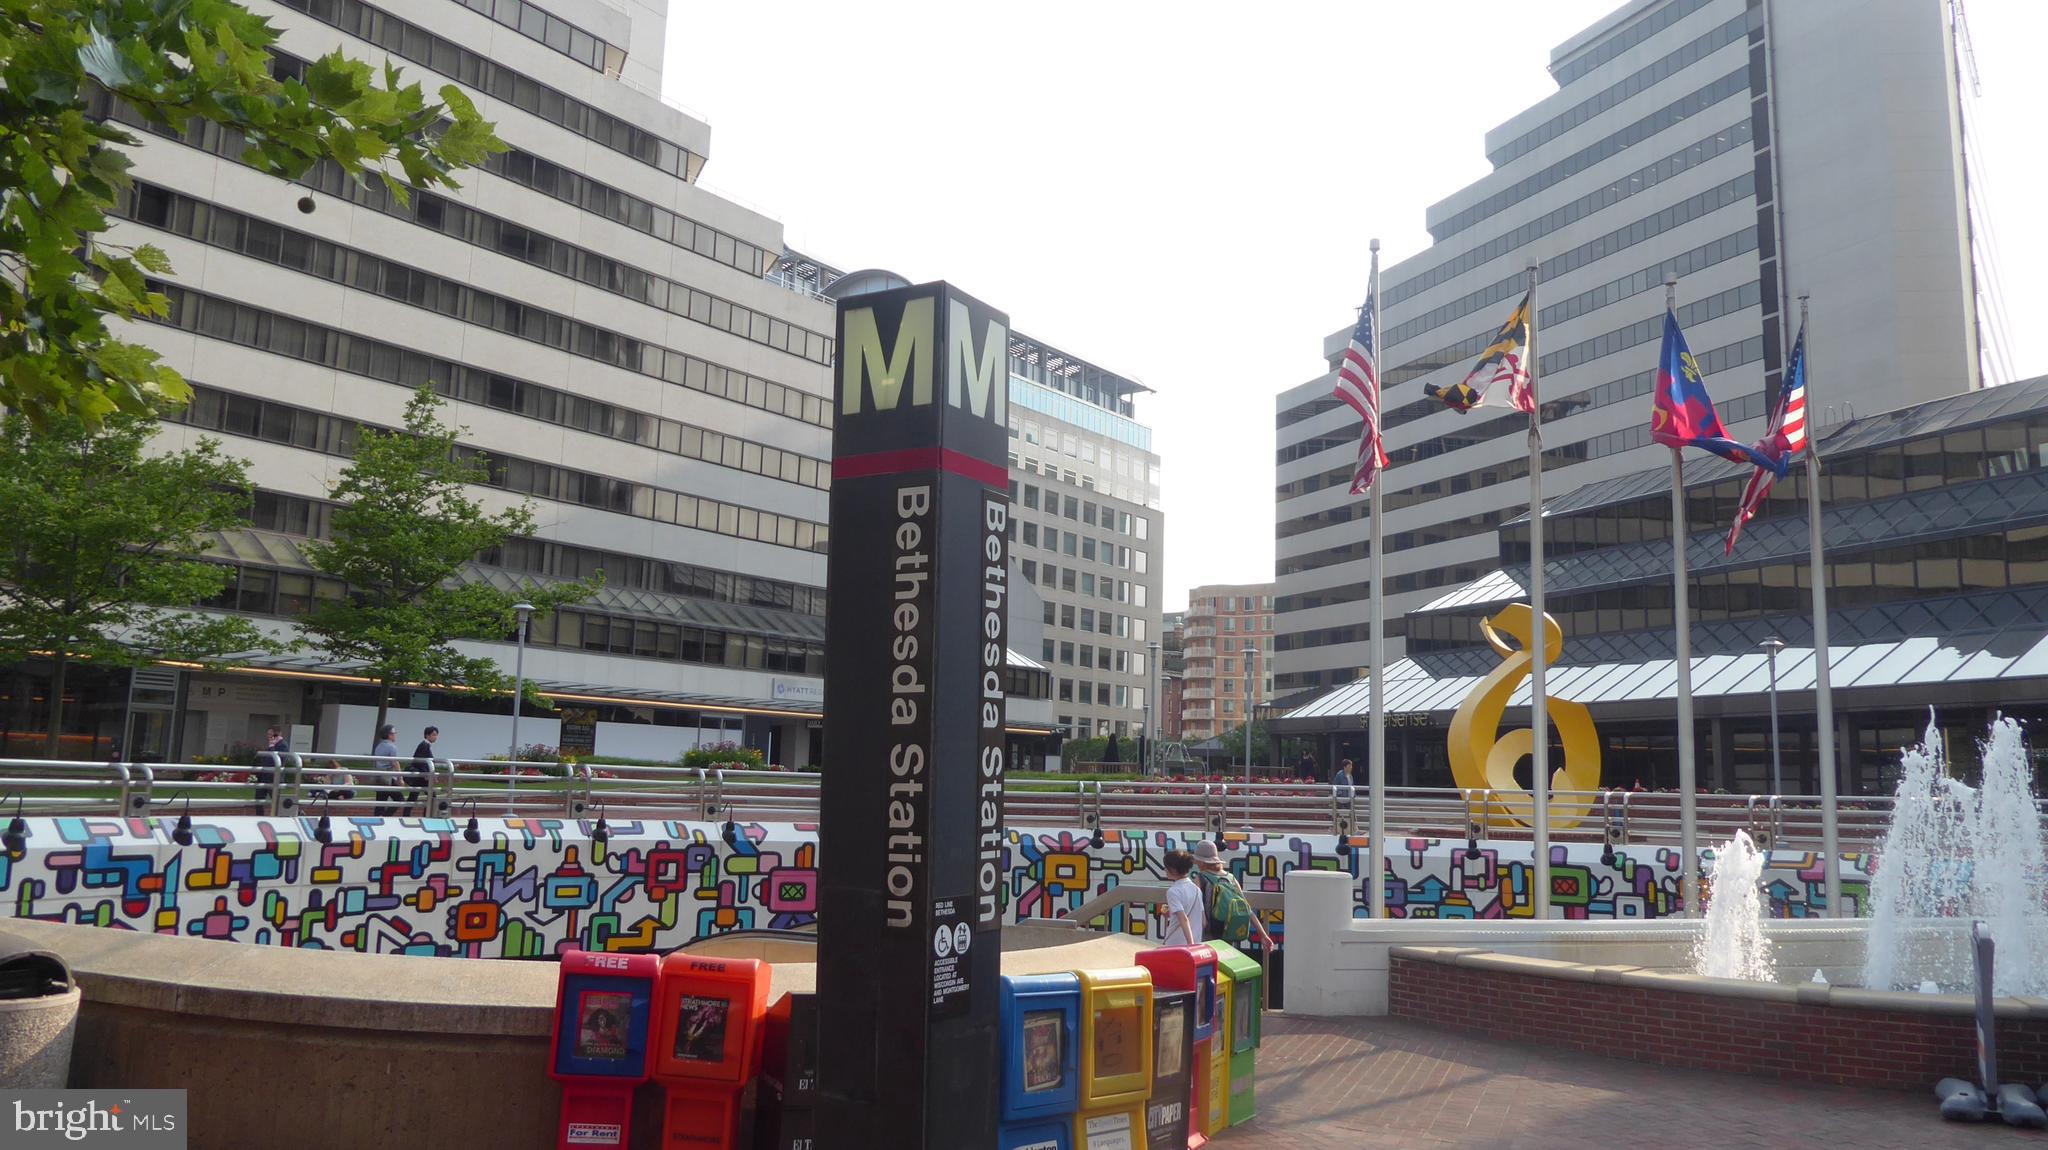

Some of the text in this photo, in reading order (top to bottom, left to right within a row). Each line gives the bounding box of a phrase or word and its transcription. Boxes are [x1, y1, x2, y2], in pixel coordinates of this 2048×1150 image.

[842, 296, 935, 416] M
[948, 297, 1006, 428] M
[887, 485, 930, 928] Bethesda Station
[979, 499, 1006, 922] Bethesda Station
[935, 900, 954, 909] RED LINE
[935, 908, 956, 917] BETHESDA
[585, 955, 630, 970] FREE
[689, 961, 726, 972] FREE
[934, 957, 958, 966] ACCESSIBLE
[934, 965, 955, 974] ENTRANCE
[933, 973, 951, 982] LOCATED
[934, 979, 956, 989] WISCONSIN
[933, 984, 970, 997] AND MONTGOMERY
[933, 996, 944, 1004] LANE
[570, 1129, 618, 1138] For Rent
